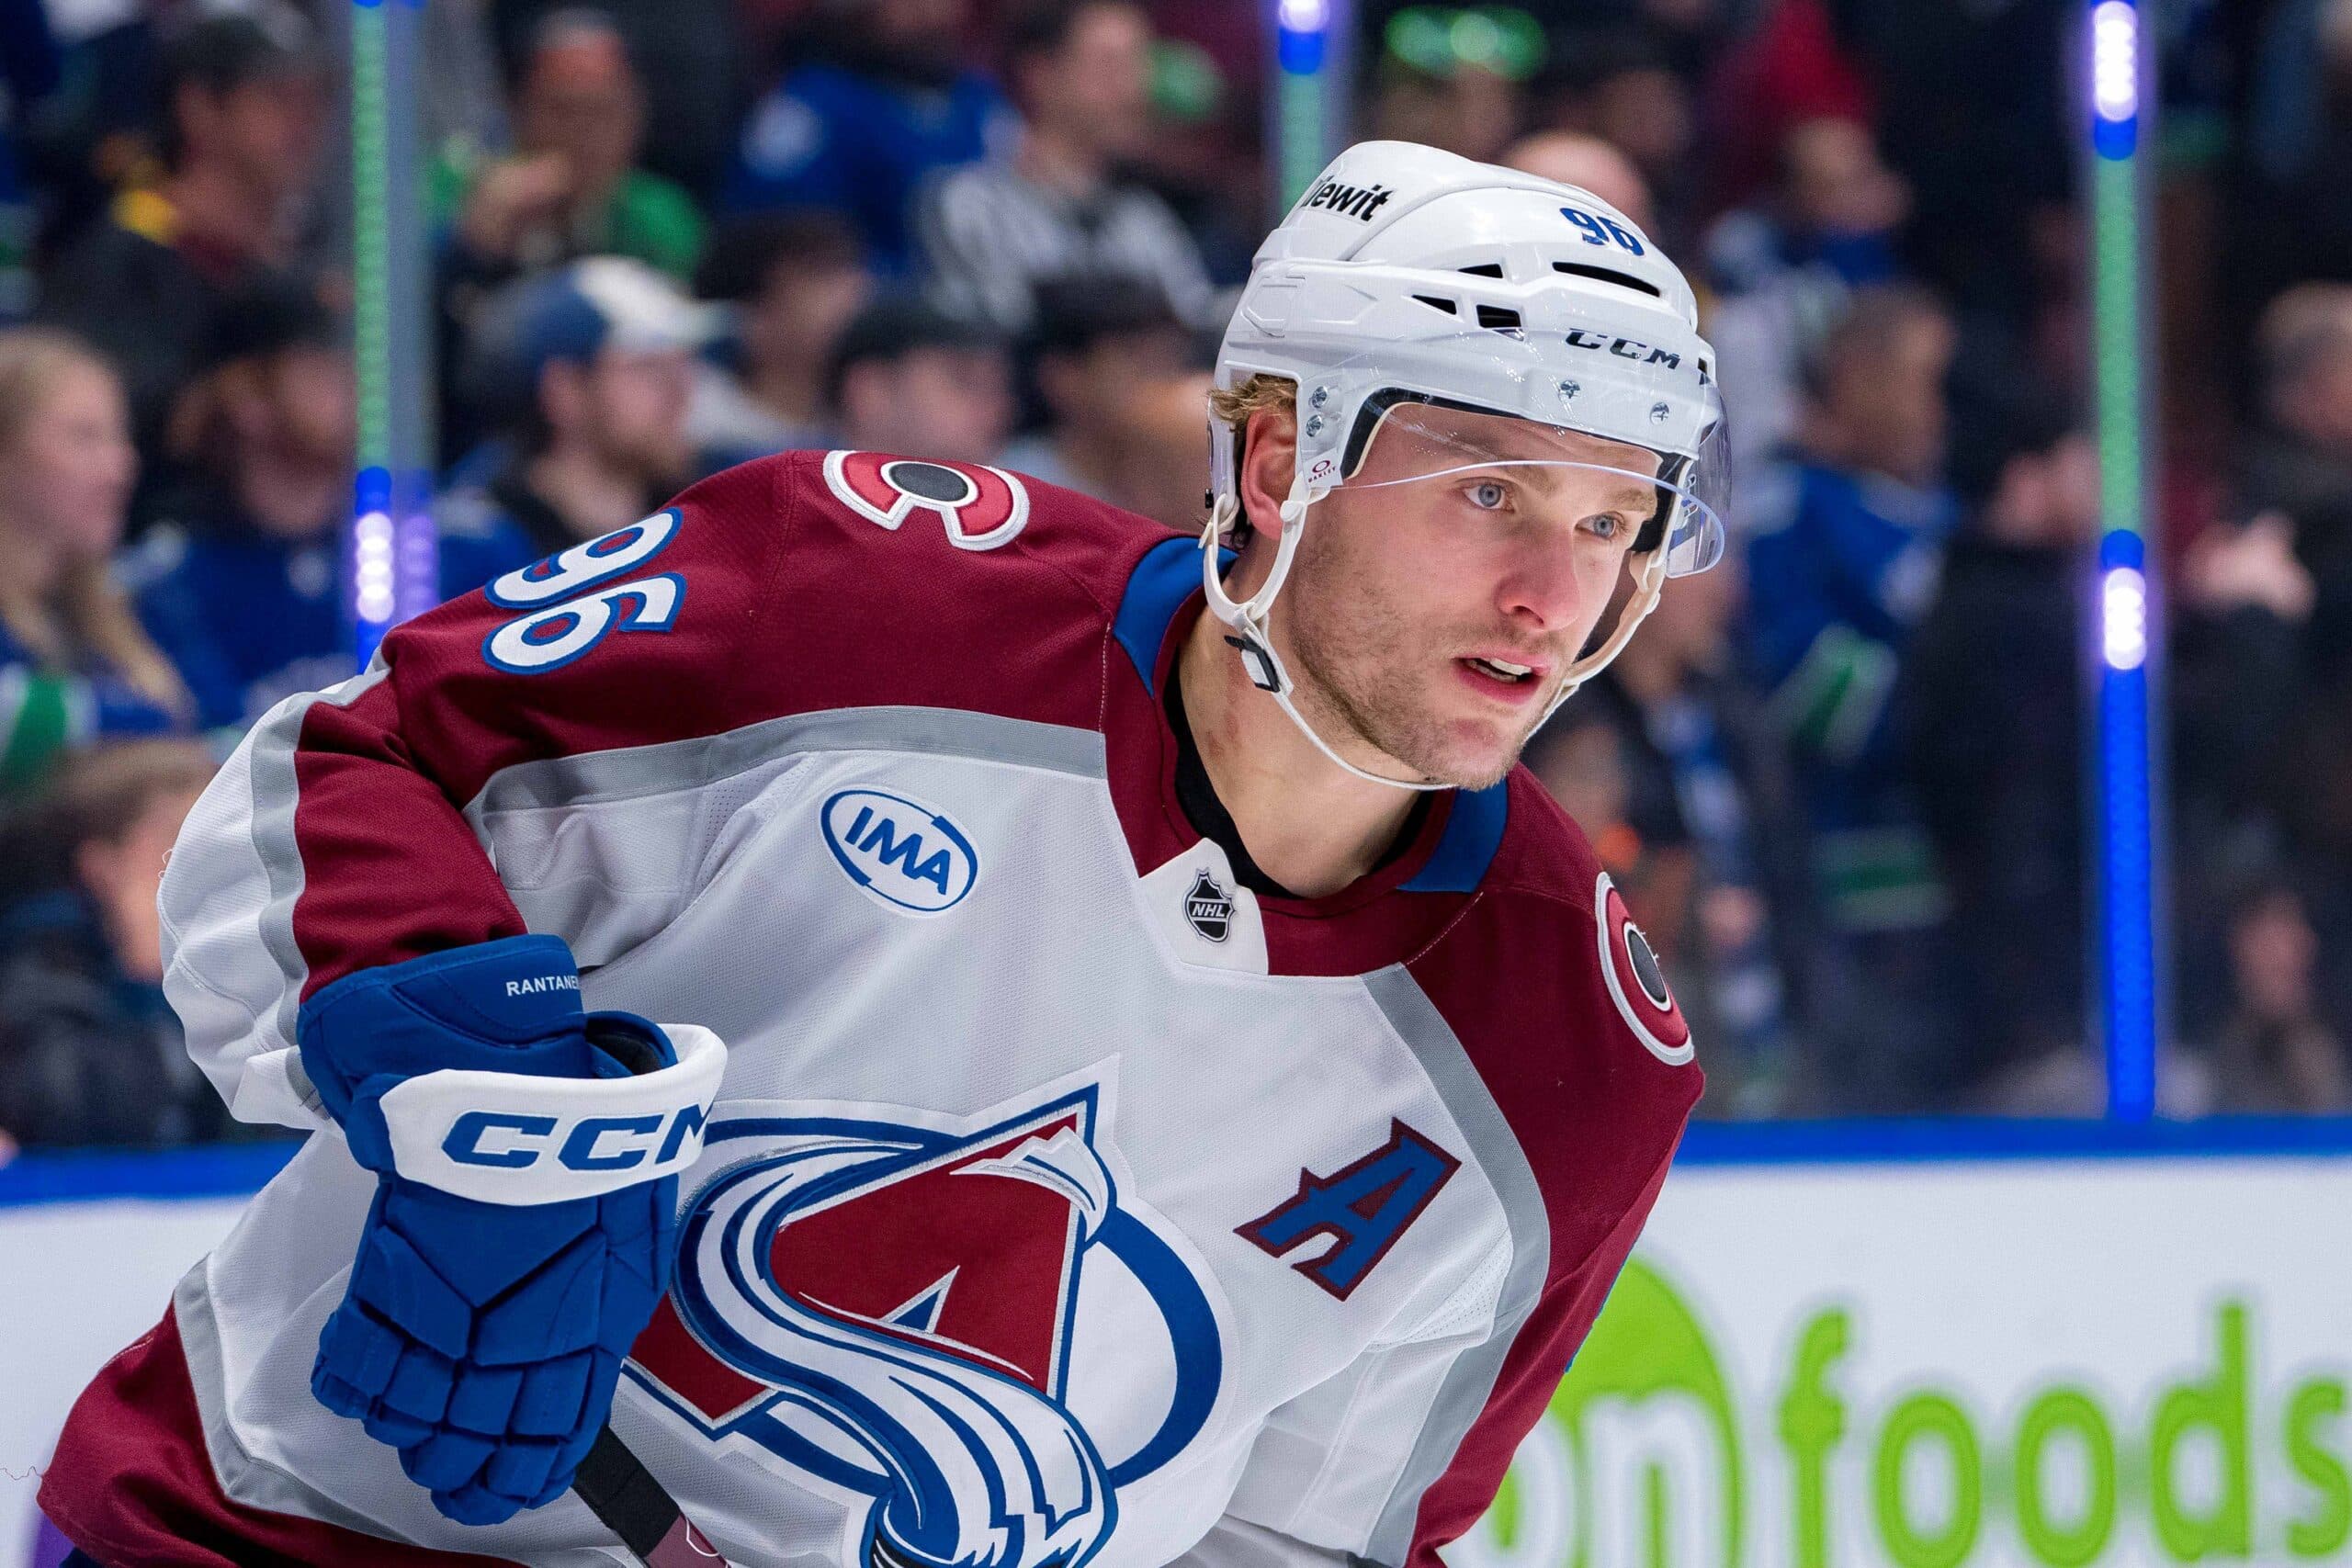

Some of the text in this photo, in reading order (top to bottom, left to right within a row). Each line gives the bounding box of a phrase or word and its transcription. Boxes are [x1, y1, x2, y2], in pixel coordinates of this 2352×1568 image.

[1559, 207, 1645, 256] 96
[1565, 327, 1681, 370] CCM
[481, 507, 687, 675] 96
[844, 807, 952, 896] IMA
[1192, 903, 1227, 917] NHL
[505, 975, 580, 997] RANTANE
[1232, 1116, 1463, 1303] A
[1775, 1300, 2352, 1568] foods
